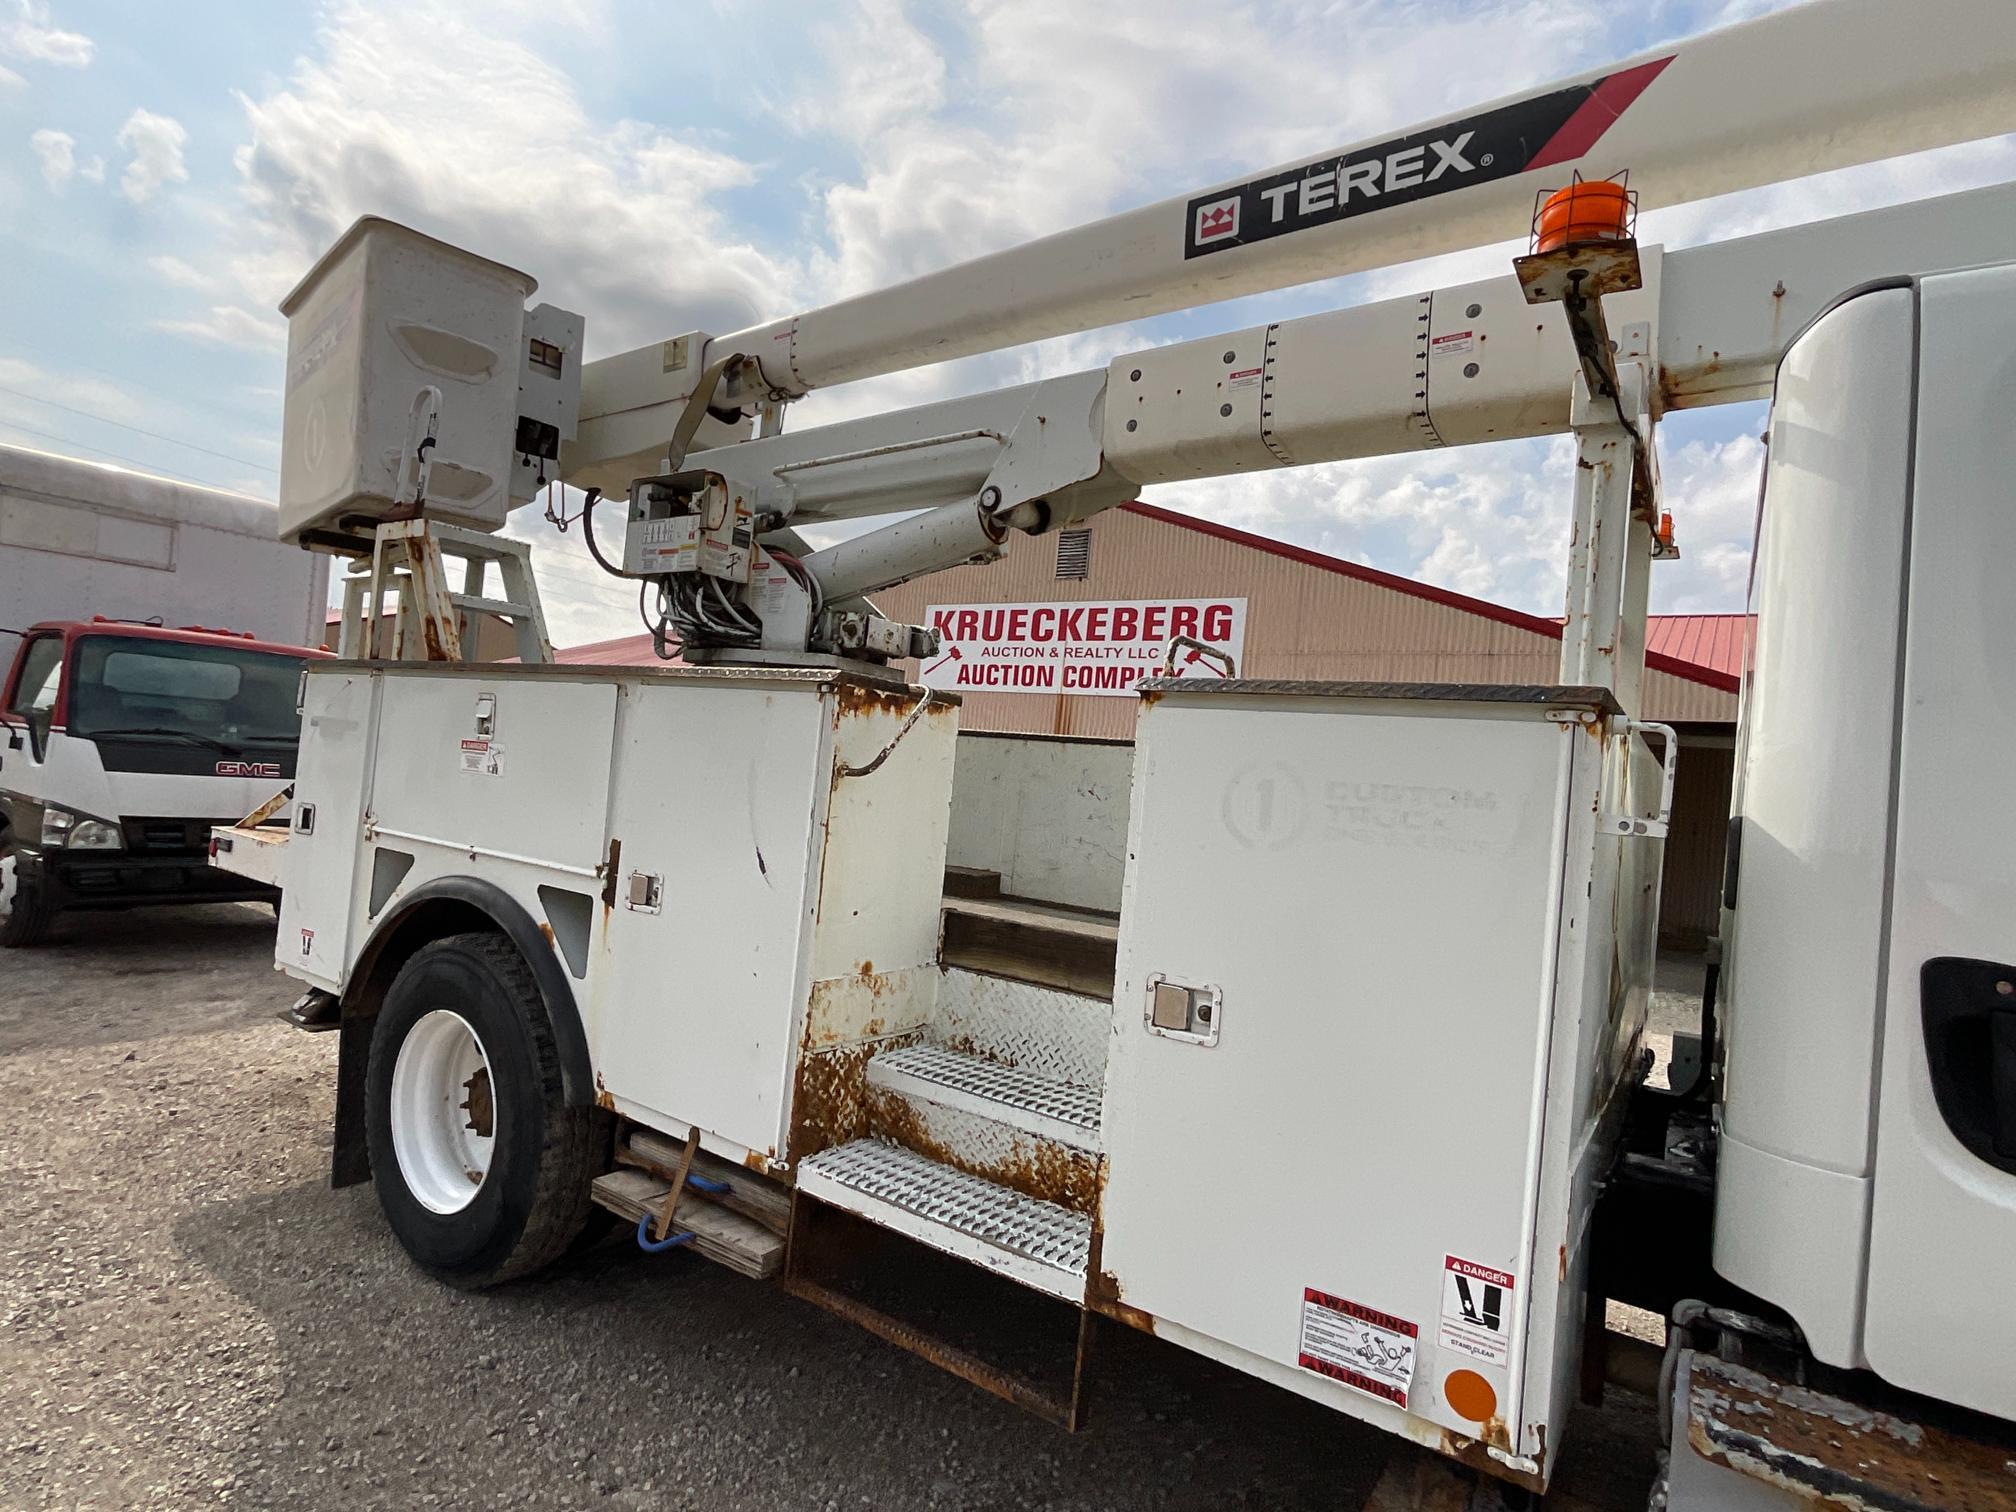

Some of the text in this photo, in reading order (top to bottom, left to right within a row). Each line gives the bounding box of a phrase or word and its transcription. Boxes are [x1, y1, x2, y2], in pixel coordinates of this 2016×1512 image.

[1261, 131, 1476, 223] TEREX
[934, 605, 1233, 642] KRUECKEBERG
[981, 646, 1159, 659] AUCTION & REALTY LLC
[957, 664, 1186, 690] AUCTION COMP
[216, 761, 281, 777] GMC
[1463, 1264, 1508, 1285] DANGER
[1322, 1293, 1412, 1333] WARNING
[1450, 1339, 1495, 1359] STAND CLEAR
[1322, 1362, 1405, 1403] WARNING
